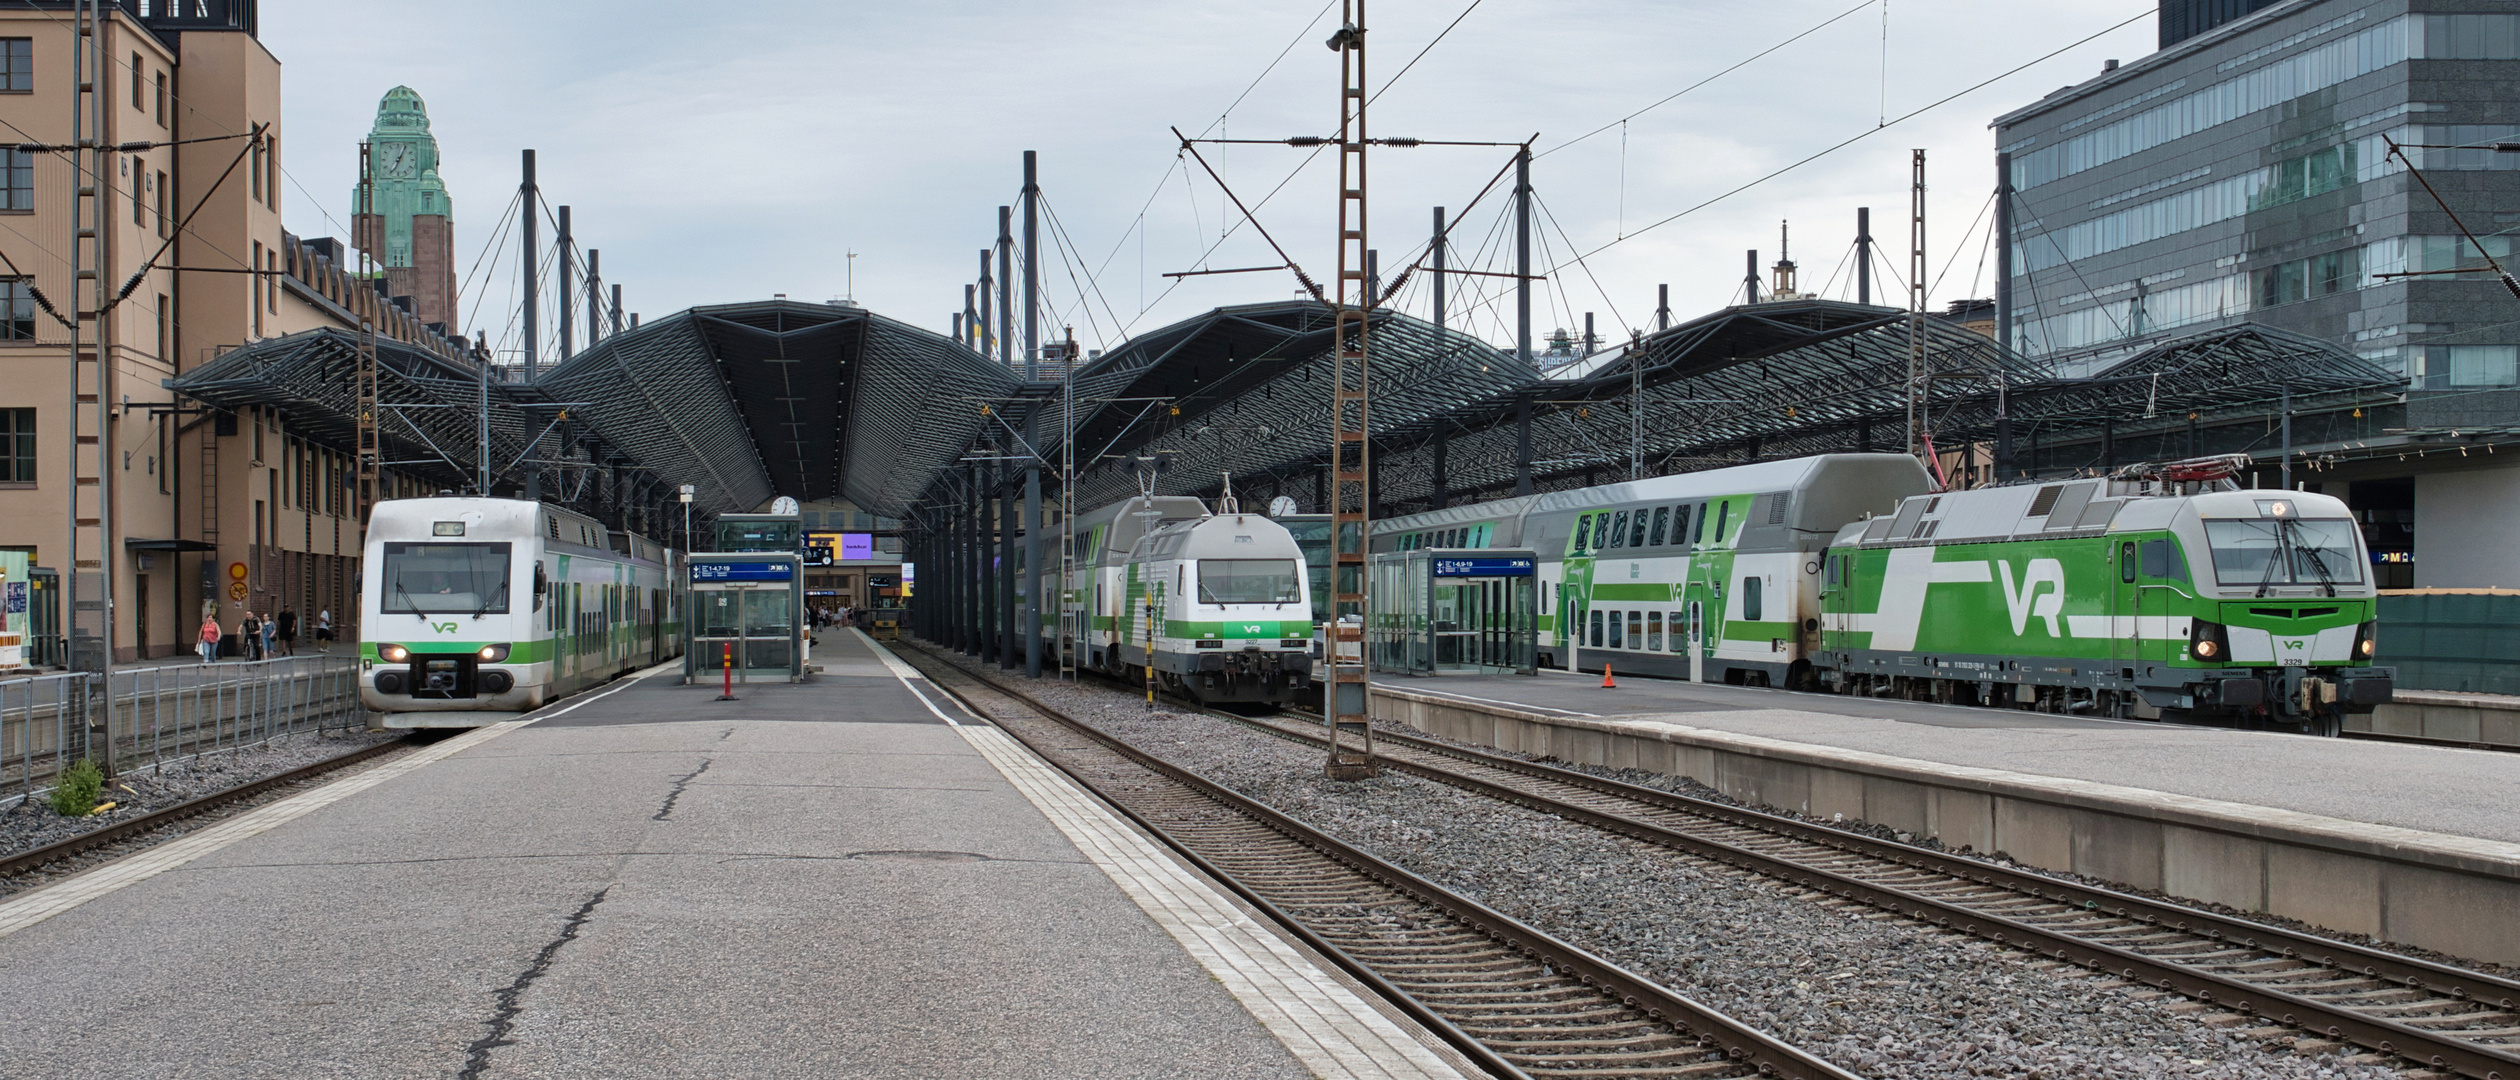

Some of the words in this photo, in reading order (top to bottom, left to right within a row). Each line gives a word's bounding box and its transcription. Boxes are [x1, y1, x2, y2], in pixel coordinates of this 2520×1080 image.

[2390, 552, 2400, 562] M
[1998, 558, 2064, 638] VR
[431, 622, 458, 634] VR
[1244, 625, 1260, 634] VR
[2283, 640, 2304, 650] VR
